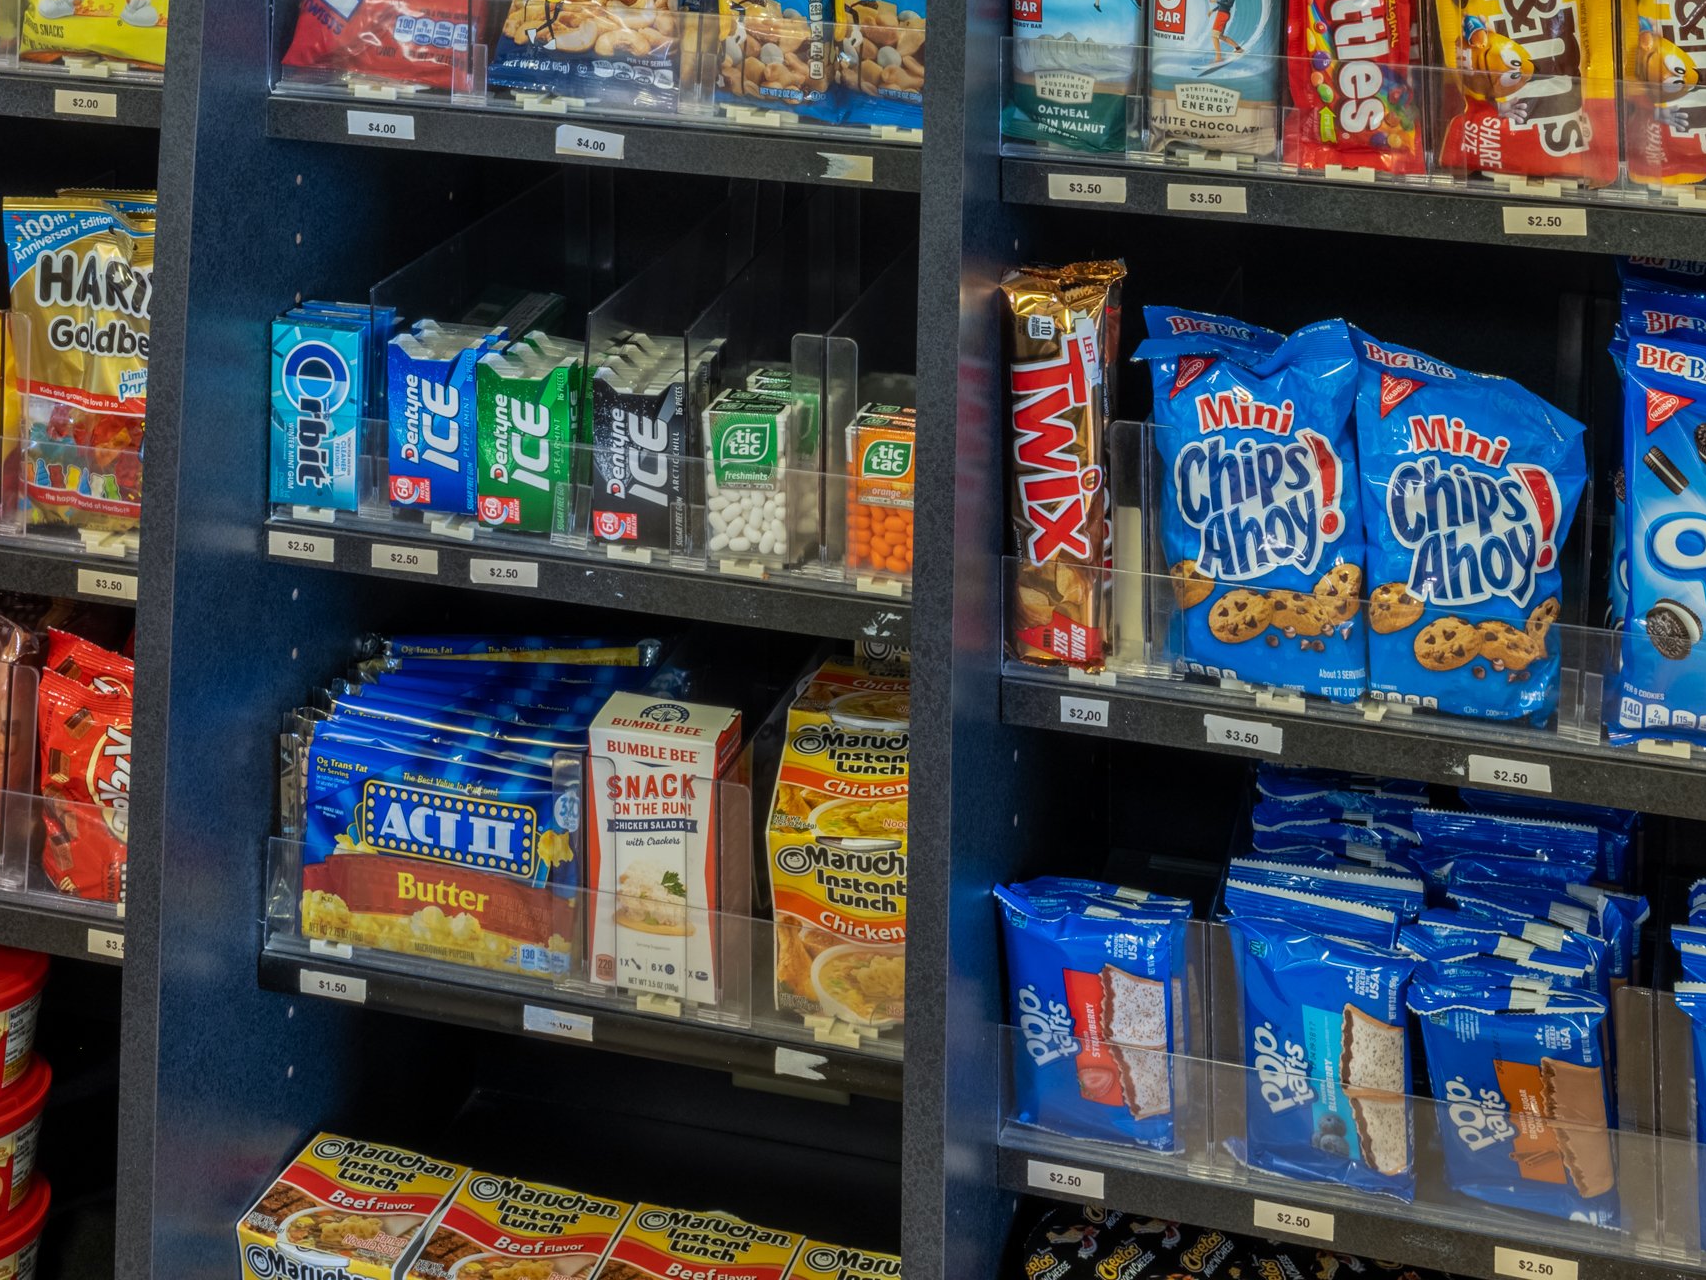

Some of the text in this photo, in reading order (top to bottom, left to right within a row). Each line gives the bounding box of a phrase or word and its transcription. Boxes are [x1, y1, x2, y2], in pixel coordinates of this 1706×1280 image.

[72, 99, 98, 108] $2.00
[1038, 104, 1089, 120] OATMEAL
[577, 140, 605, 152] $4.00
[1527, 216, 1562, 228] $2.50
[1637, 344, 1685, 376] BIG
[1198, 392, 1293, 435] Mini
[491, 394, 507, 481] Dentyne
[513, 399, 550, 490] ICE
[729, 440, 762, 455] tac
[736, 429, 760, 443] tic
[724, 471, 768, 482] freshmints
[1181, 438, 1309, 525] Chips
[288, 541, 315, 553] $2.50
[1225, 729, 1259, 744] $3.50
[379, 803, 463, 850] ACT
[396, 873, 489, 912] Butter
[819, 910, 907, 940] Chicken
[318, 979, 347, 994] $1.50
[336, 1155, 417, 1186] Instant
[341, 1139, 455, 1181] Maruchan
[334, 1169, 399, 1192] Lunch
[328, 1189, 414, 1212] Beef Flavor
[1276, 1215, 1310, 1228] $2.50
